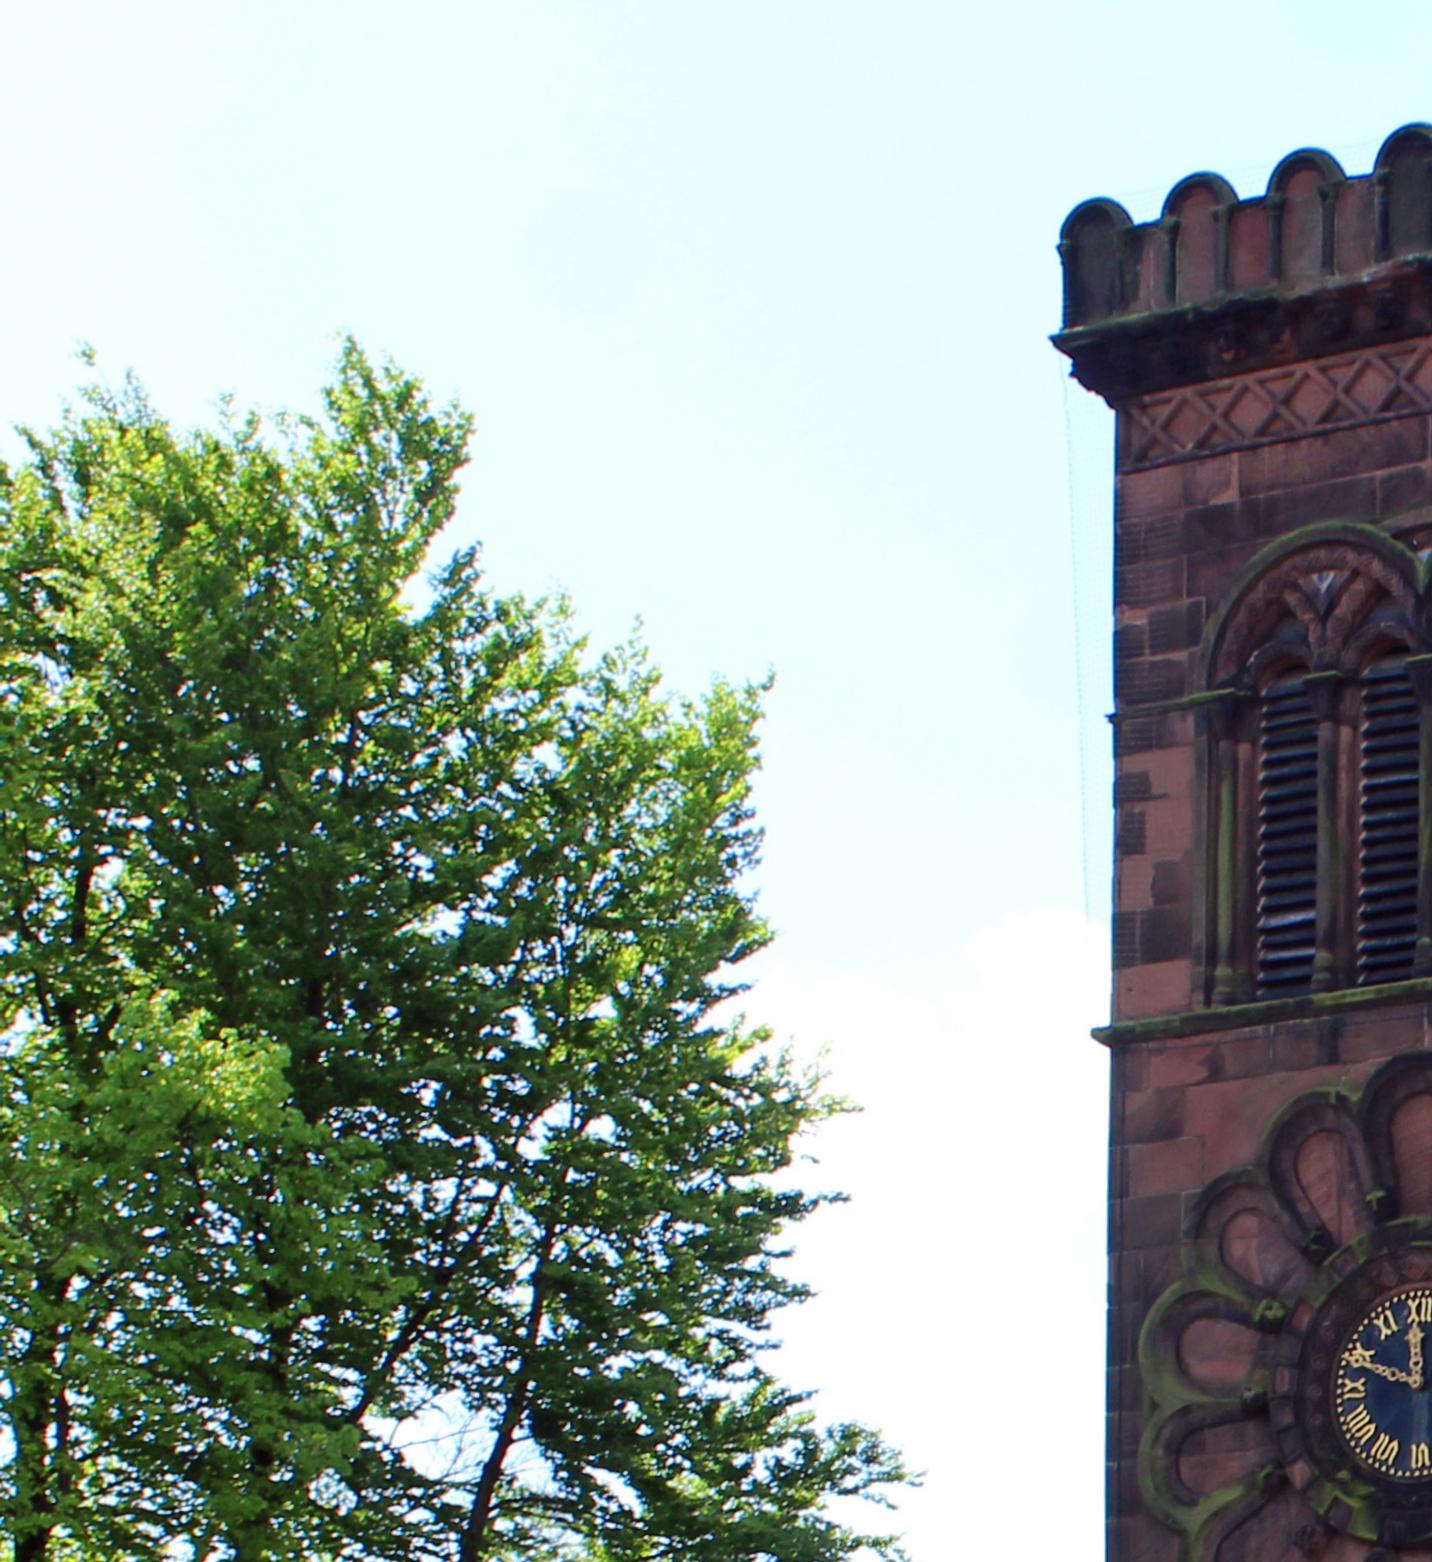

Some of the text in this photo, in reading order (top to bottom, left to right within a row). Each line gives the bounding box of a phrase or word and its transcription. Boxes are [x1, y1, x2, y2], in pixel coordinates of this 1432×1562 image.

[1407, 1297, 1432, 1323] XII
[1373, 1309, 1400, 1341] XI
[1343, 1377, 1366, 1400] IX
[1410, 1442, 1431, 1469] VI
